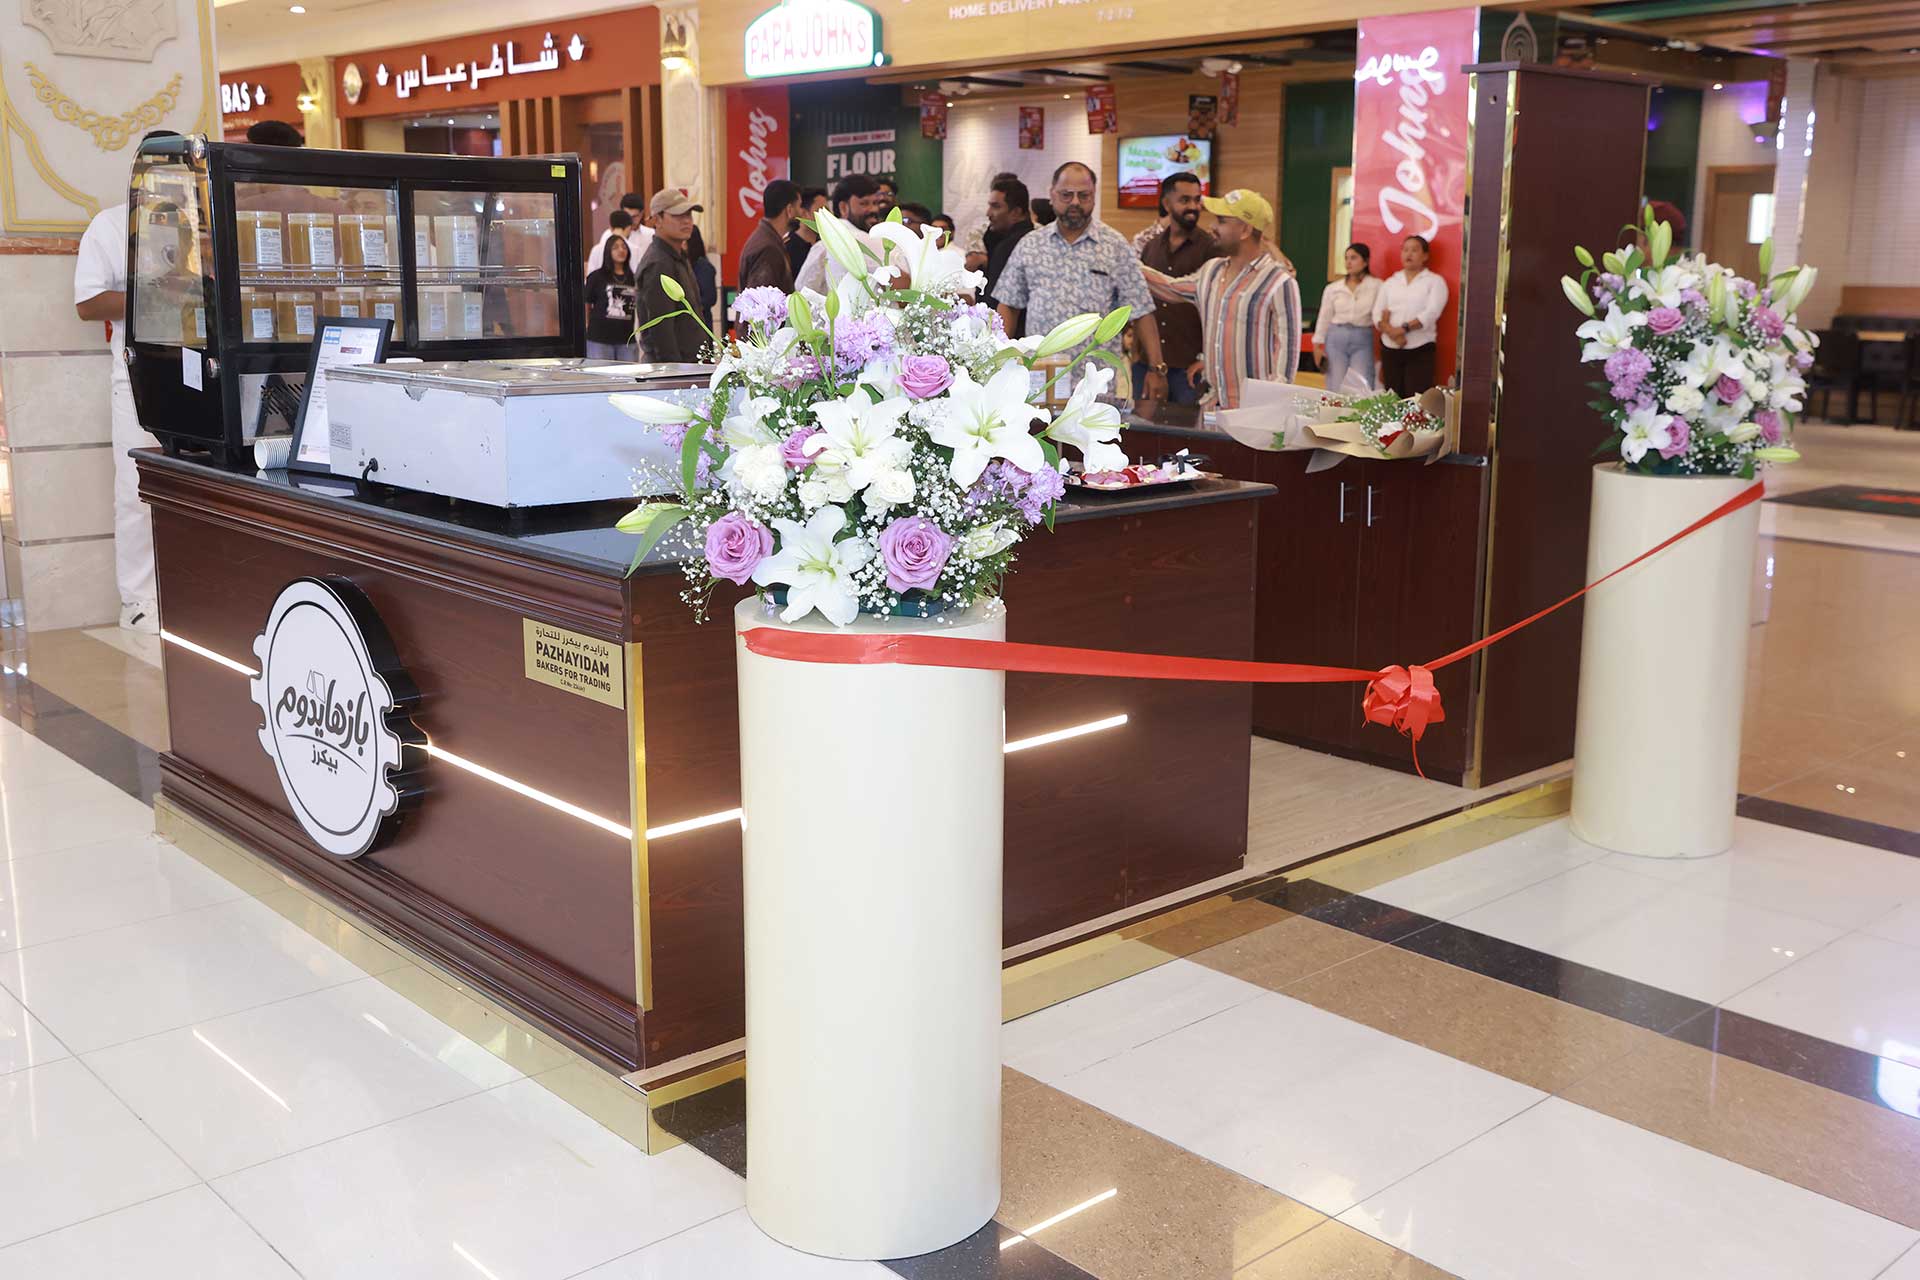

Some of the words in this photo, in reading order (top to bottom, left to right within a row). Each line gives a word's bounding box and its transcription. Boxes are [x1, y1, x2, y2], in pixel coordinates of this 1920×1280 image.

[949, 4, 986, 20] HOME
[751, 17, 794, 65] PAPA
[800, 12, 867, 58] JOHNS
[395, 53, 468, 98] عباس
[470, 31, 559, 90] شاطر
[738, 106, 778, 218] Johns
[826, 148, 896, 179] FLOUR
[536, 640, 609, 678] PAZHAYIDAM
[536, 659, 563, 676] BAKERS
[564, 669, 578, 681] FOR
[579, 673, 611, 692] TRADING
[276, 679, 369, 757] بازهايدوم
[311, 744, 338, 775] بيكرز
